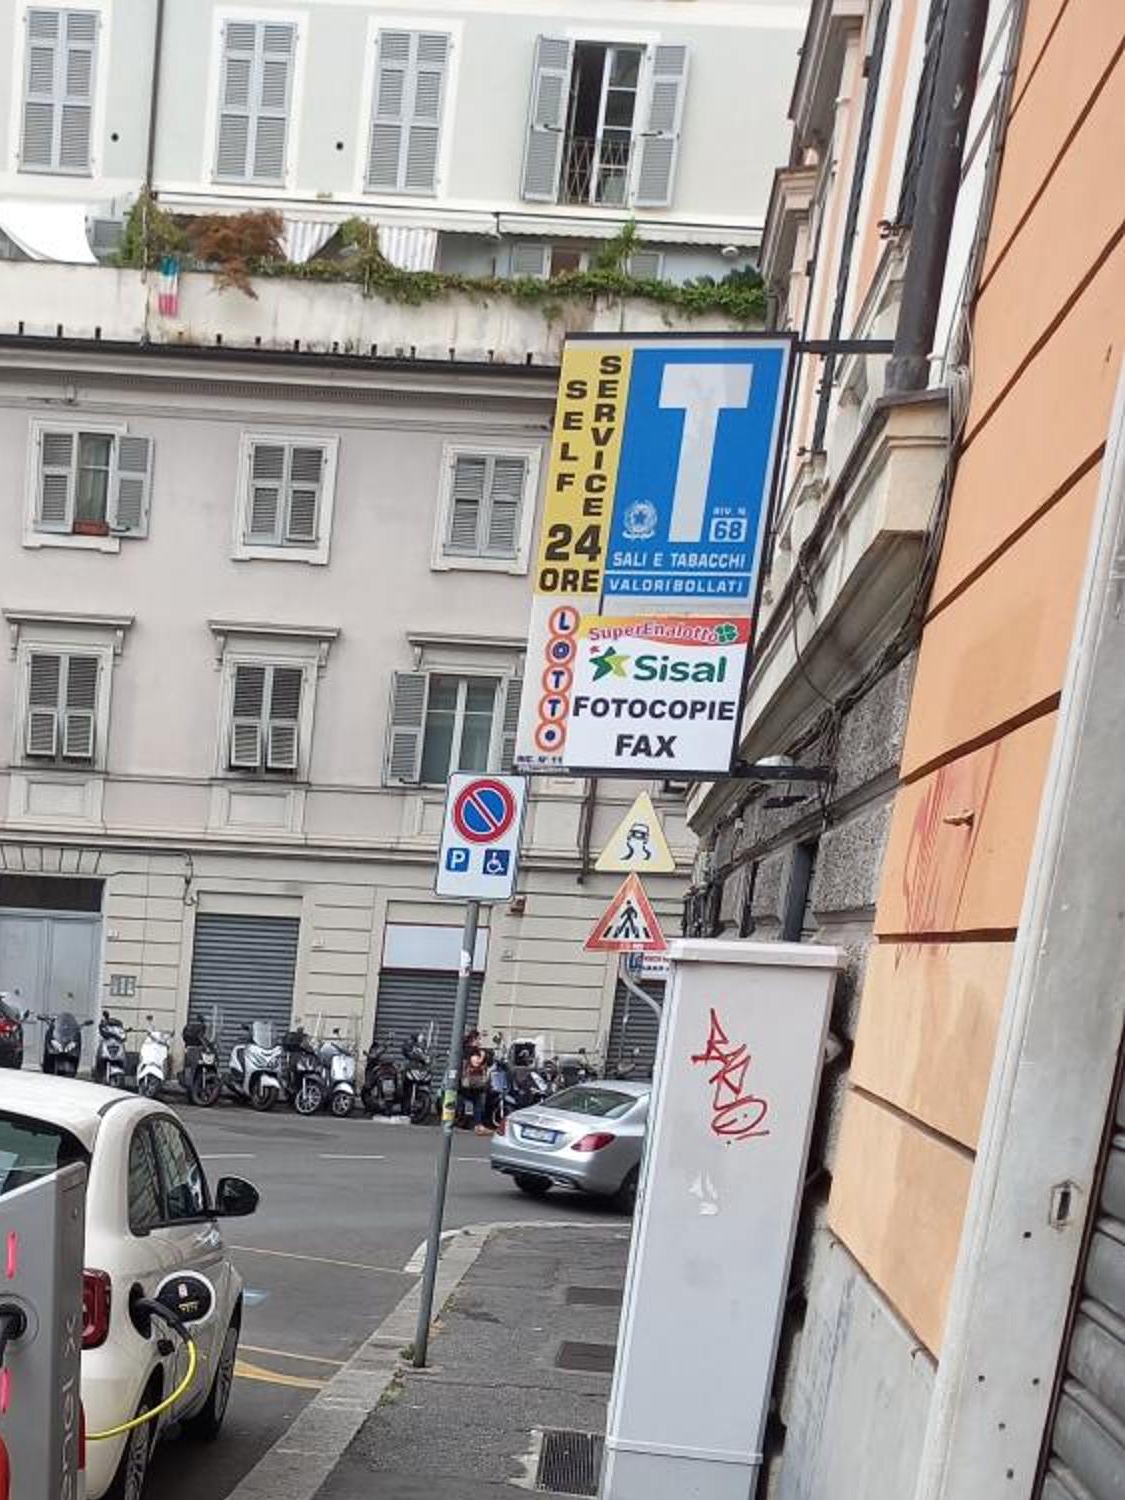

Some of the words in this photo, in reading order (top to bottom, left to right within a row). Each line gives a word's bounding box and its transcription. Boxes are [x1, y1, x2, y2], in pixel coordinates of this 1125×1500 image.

[556, 380, 587, 492] SELF
[583, 354, 622, 518] SERVICE
[659, 363, 753, 543] T
[713, 519, 743, 541] 68
[544, 523, 602, 564] 24
[612, 551, 646, 568] SALI
[652, 552, 664, 567] E
[671, 552, 746, 569] TABACCHI
[538, 566, 600, 594] ORE
[609, 578, 670, 592] VALORI
[672, 579, 743, 593] BOLLATI
[588, 622, 718, 645] SuperEnalotto
[540, 610, 573, 746] LOTTO
[633, 654, 727, 683] Sisal
[572, 696, 736, 721] FOTOCOPIE
[614, 733, 678, 758] FAX
[450, 849, 466, 869] P
